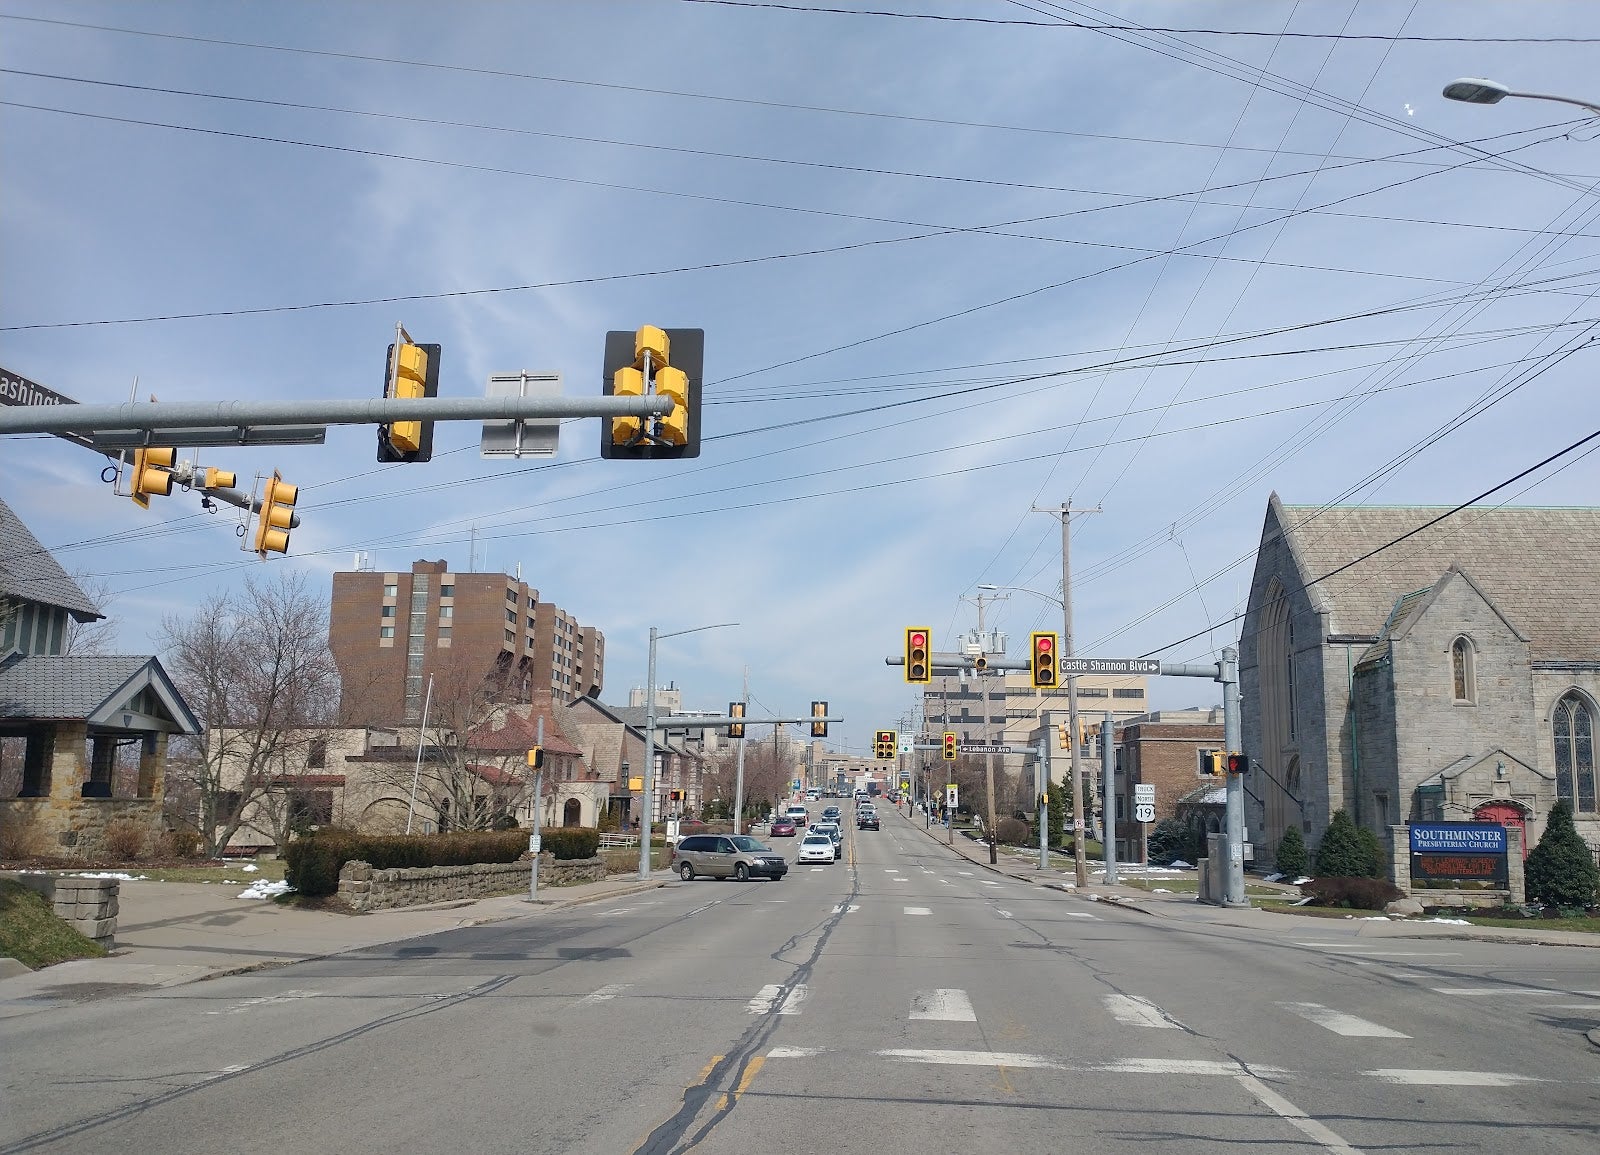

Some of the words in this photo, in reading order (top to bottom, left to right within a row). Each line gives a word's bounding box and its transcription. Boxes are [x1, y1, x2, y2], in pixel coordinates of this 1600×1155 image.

[1061, 660, 1088, 670] Castle
[1090, 661, 1127, 671] Shannon
[1129, 661, 1148, 671] Blvd
[1140, 808, 1152, 818] 19
[1414, 829, 1501, 840] SOUTHMINSTER
[1417, 840, 1467, 848] PRESBYTERIAN
[1468, 841, 1499, 849] CHURCH
